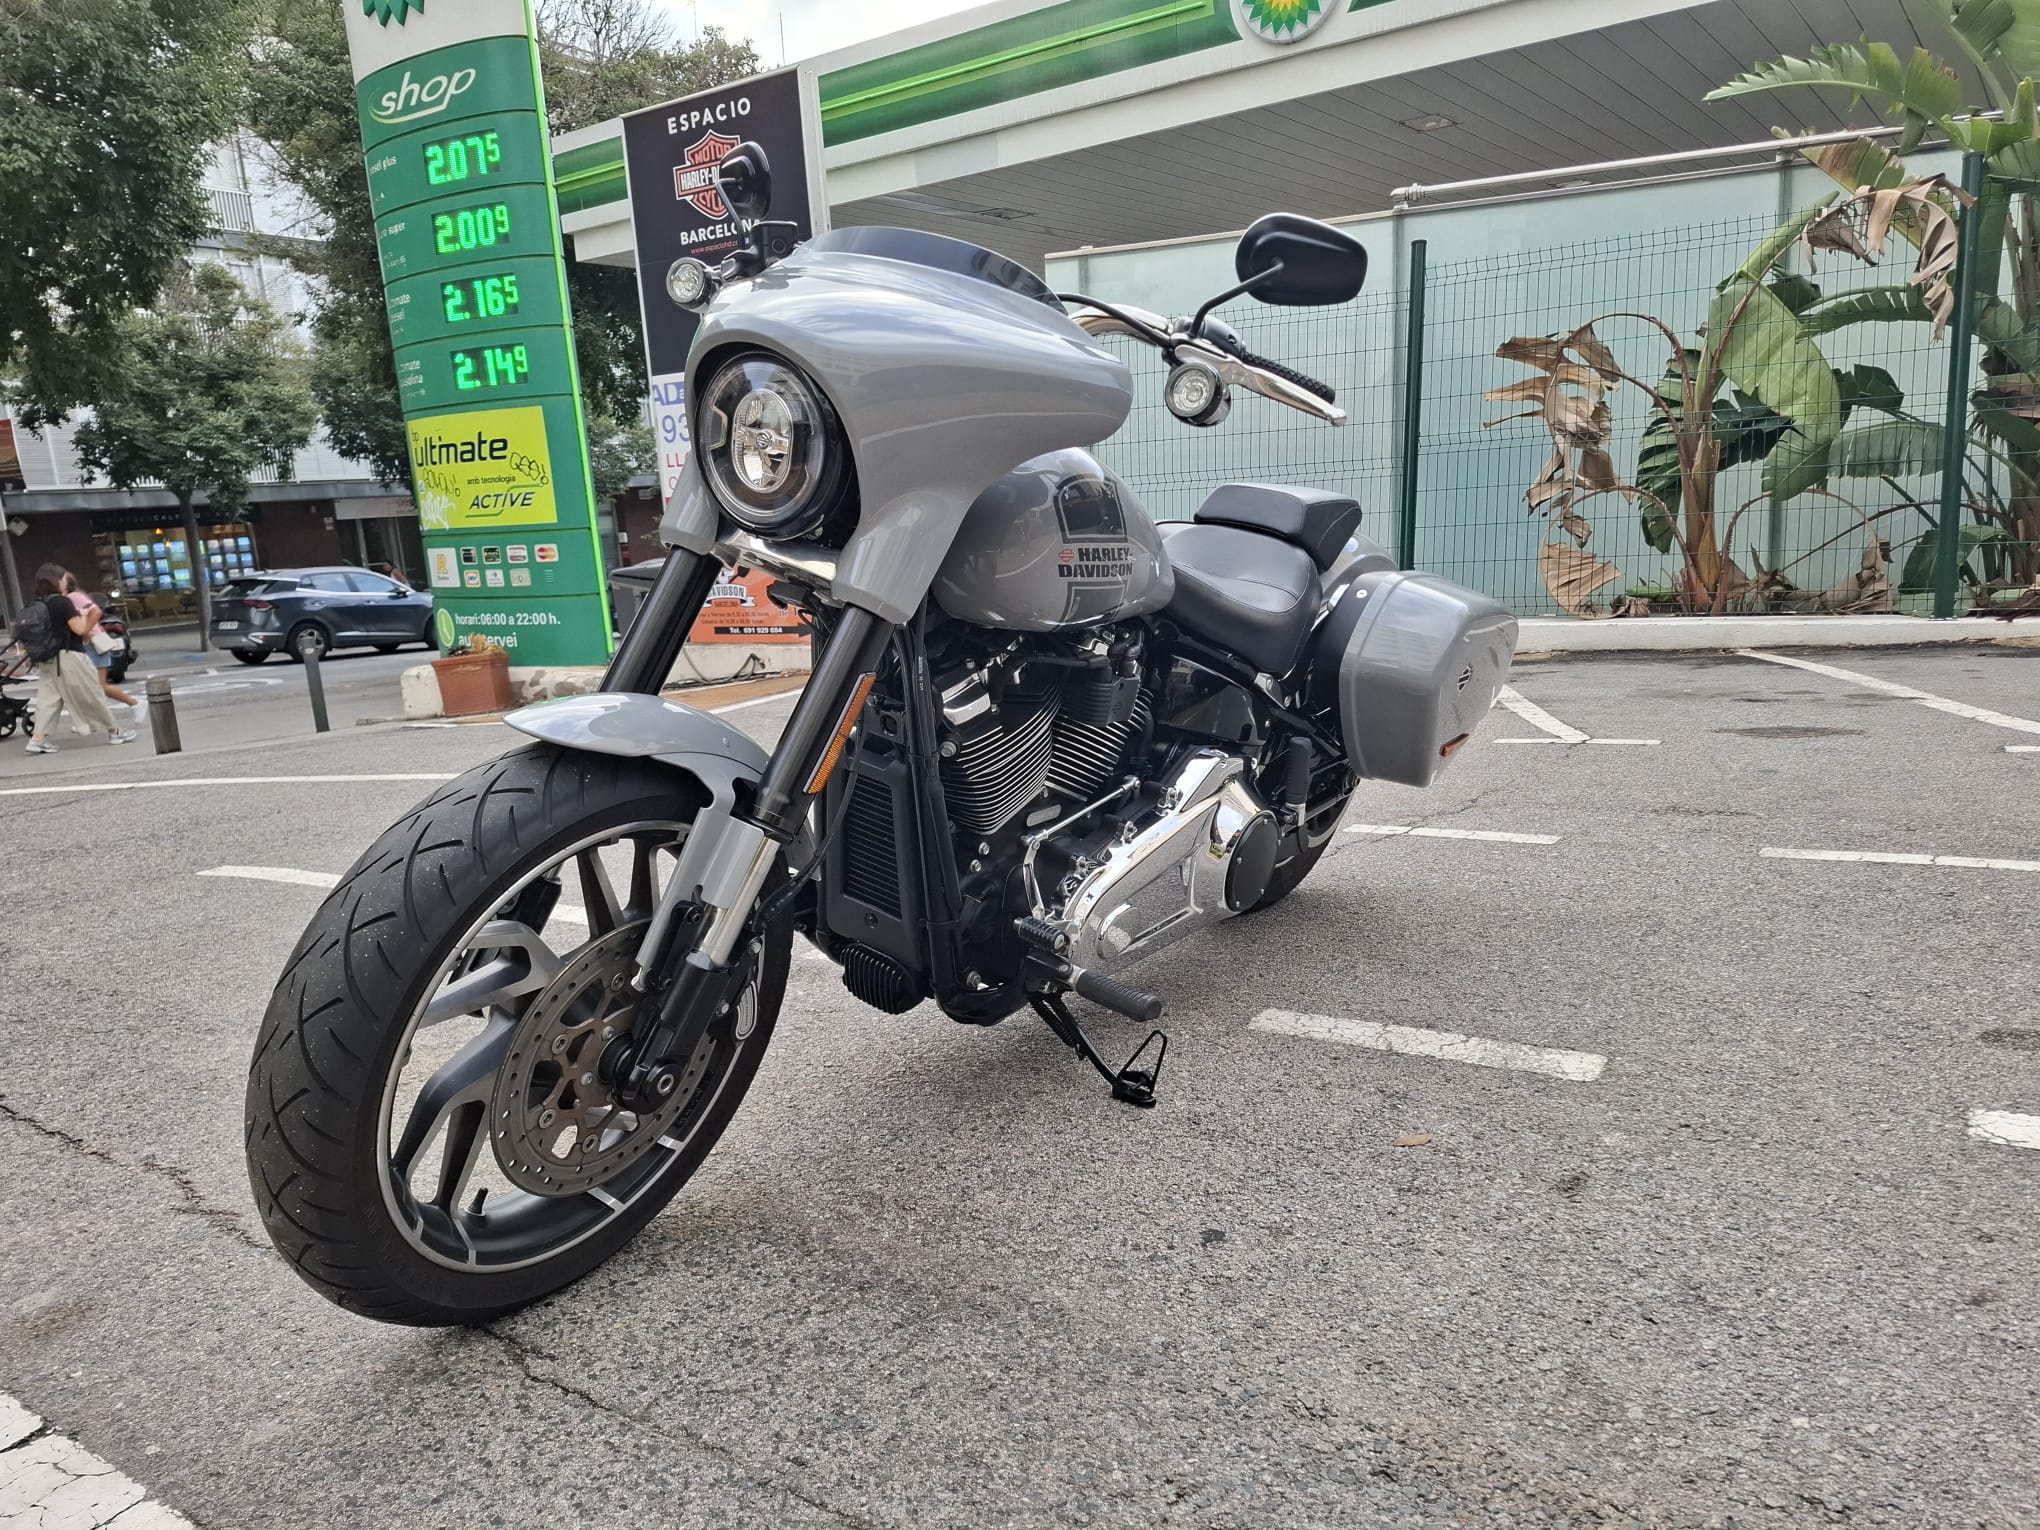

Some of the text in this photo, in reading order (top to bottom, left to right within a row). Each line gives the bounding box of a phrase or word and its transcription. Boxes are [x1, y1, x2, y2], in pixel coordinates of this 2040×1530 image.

[381, 68, 476, 116] shop
[667, 97, 751, 135] ESPACIO
[425, 132, 501, 185] 2.075
[681, 165, 720, 190] HARLEY-D
[434, 205, 510, 254] 2.009
[444, 275, 519, 322] 2.165
[453, 345, 528, 390] 2.149
[414, 431, 508, 467] ultimate
[469, 492, 536, 510] ACTIVE
[1058, 563, 1133, 578] DAVIDSON
[509, 616, 515, 625] a
[516, 612, 547, 625] 22:00
[548, 611, 561, 625] h.
[458, 632, 518, 648] auervei
